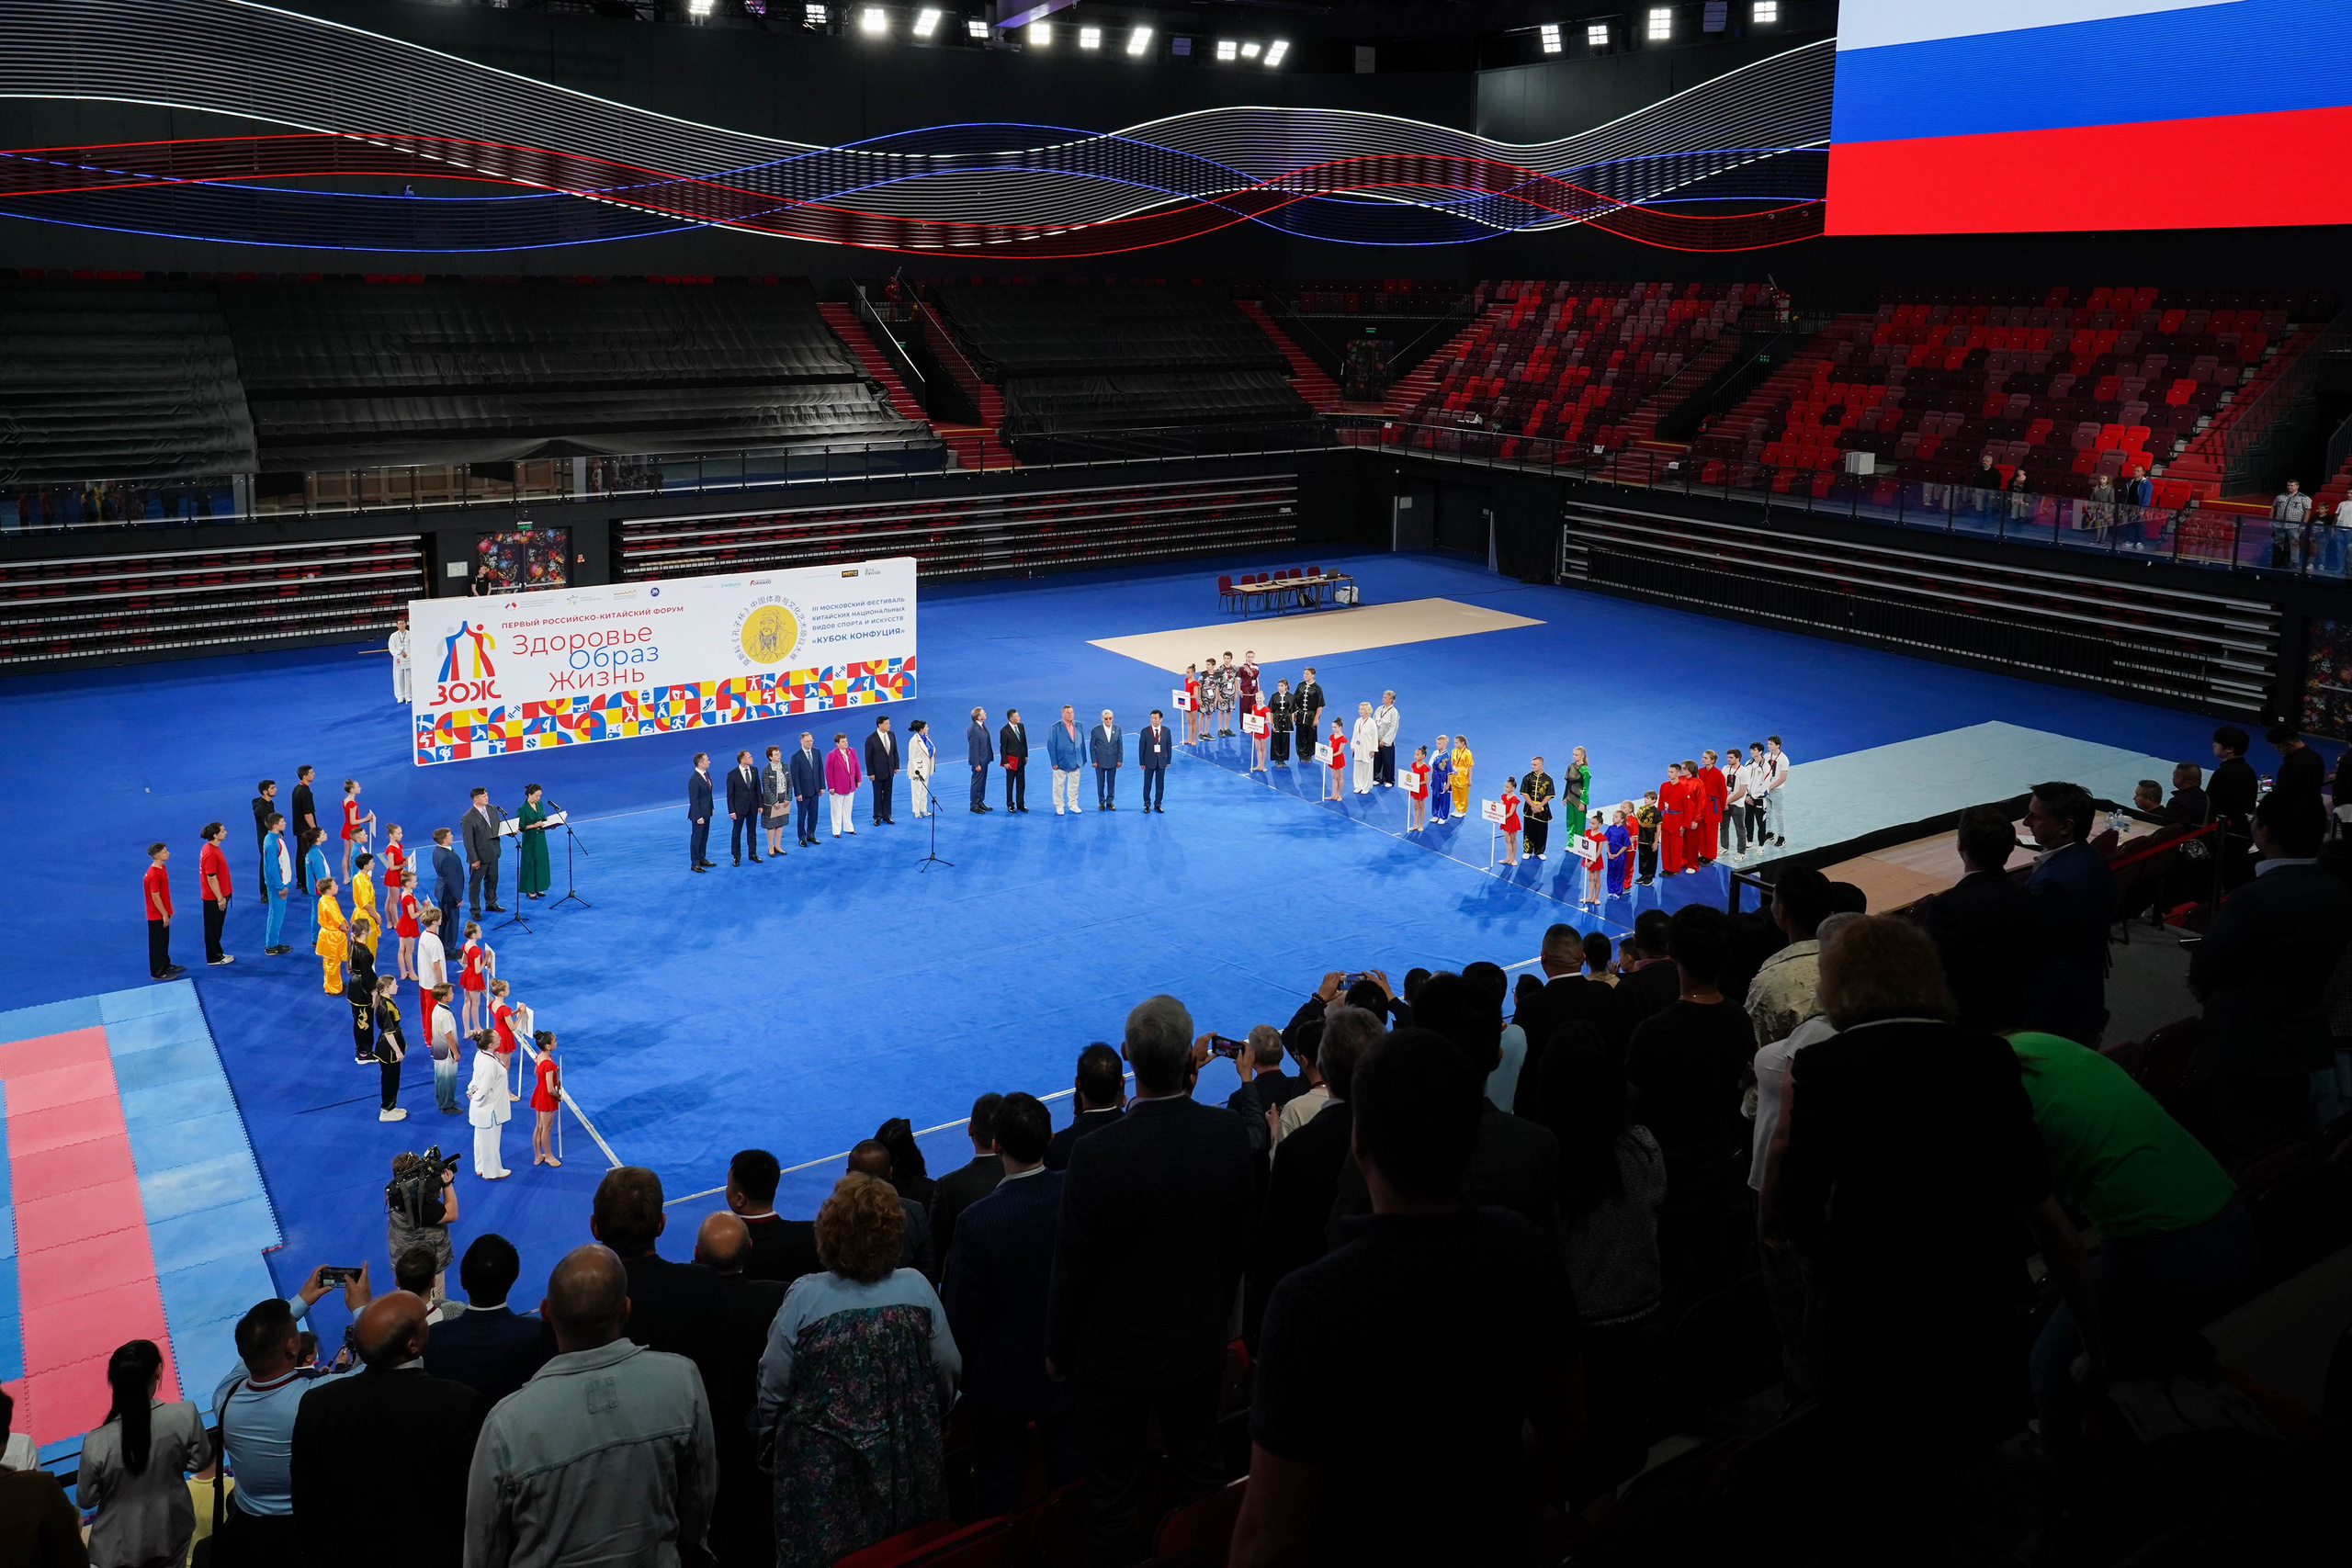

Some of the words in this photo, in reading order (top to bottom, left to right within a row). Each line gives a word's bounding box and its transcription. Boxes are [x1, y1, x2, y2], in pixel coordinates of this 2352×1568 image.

[812, 612, 851, 621] КИТАЙСКИХ
[852, 606, 906, 616] НАЦИОНАЛЬНЫХ
[820, 601, 865, 611] МОСКОВСКИЙ
[866, 597, 905, 606] ФЕСТИВАЛЬ
[502, 618, 540, 629] ПЕРВЫЙ
[542, 608, 651, 625] РОССИЙСКО-КИТАЙСКИЙ
[653, 606, 684, 615] ФОРУМ
[812, 623, 836, 631] ВИДОВ
[837, 620, 864, 628] СПОРТА
[871, 615, 904, 624] ИСКУССТВ
[513, 626, 653, 657] Здоровье
[812, 633, 848, 644] «КУБОК
[850, 627, 905, 639] КОНФУЦИЯ»
[569, 646, 660, 671] Образ
[548, 666, 645, 693] Жизнь
